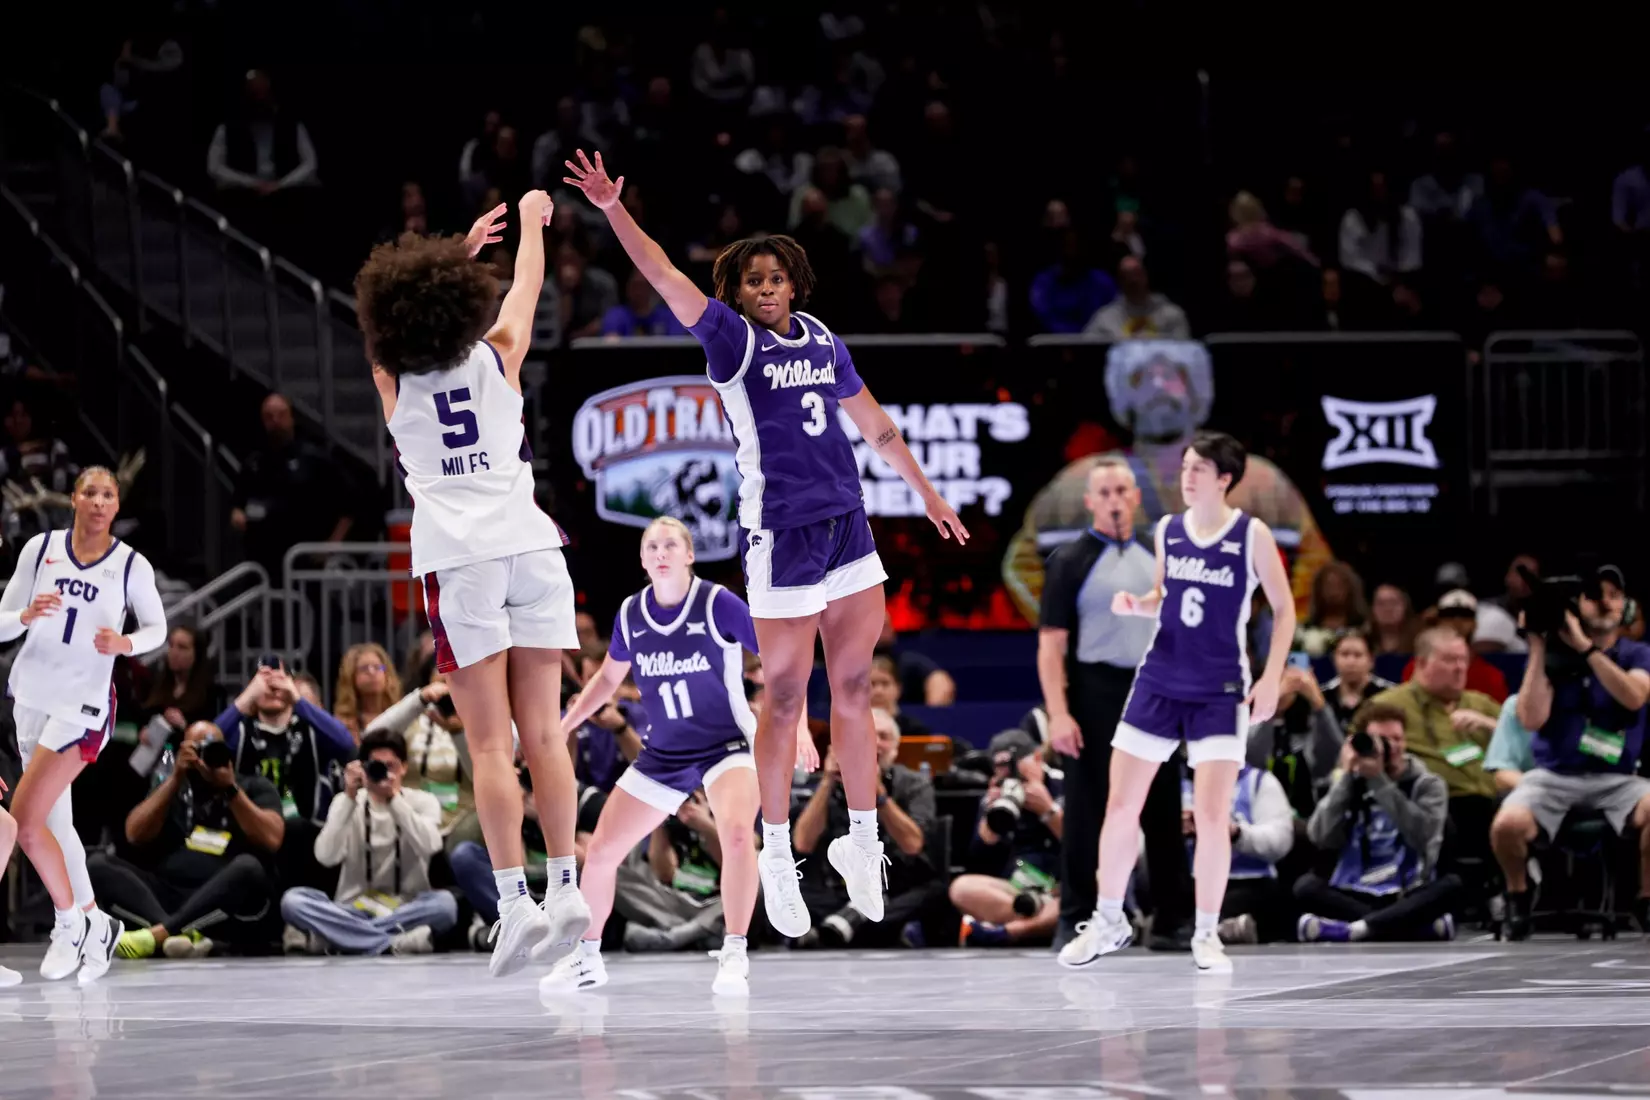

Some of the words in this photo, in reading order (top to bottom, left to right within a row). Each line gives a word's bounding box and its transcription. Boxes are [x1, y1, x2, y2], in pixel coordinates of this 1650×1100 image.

[432, 387, 480, 449] 5
[573, 403, 648, 465] OLD
[646, 386, 735, 444] TRA
[801, 391, 828, 437] 3
[54, 578, 99, 603] TCU
[1166, 554, 1234, 588] Wildcats
[62, 606, 78, 645] 1
[1180, 587, 1206, 628] 6
[635, 650, 712, 677] Wildcats
[658, 679, 694, 720] 11
